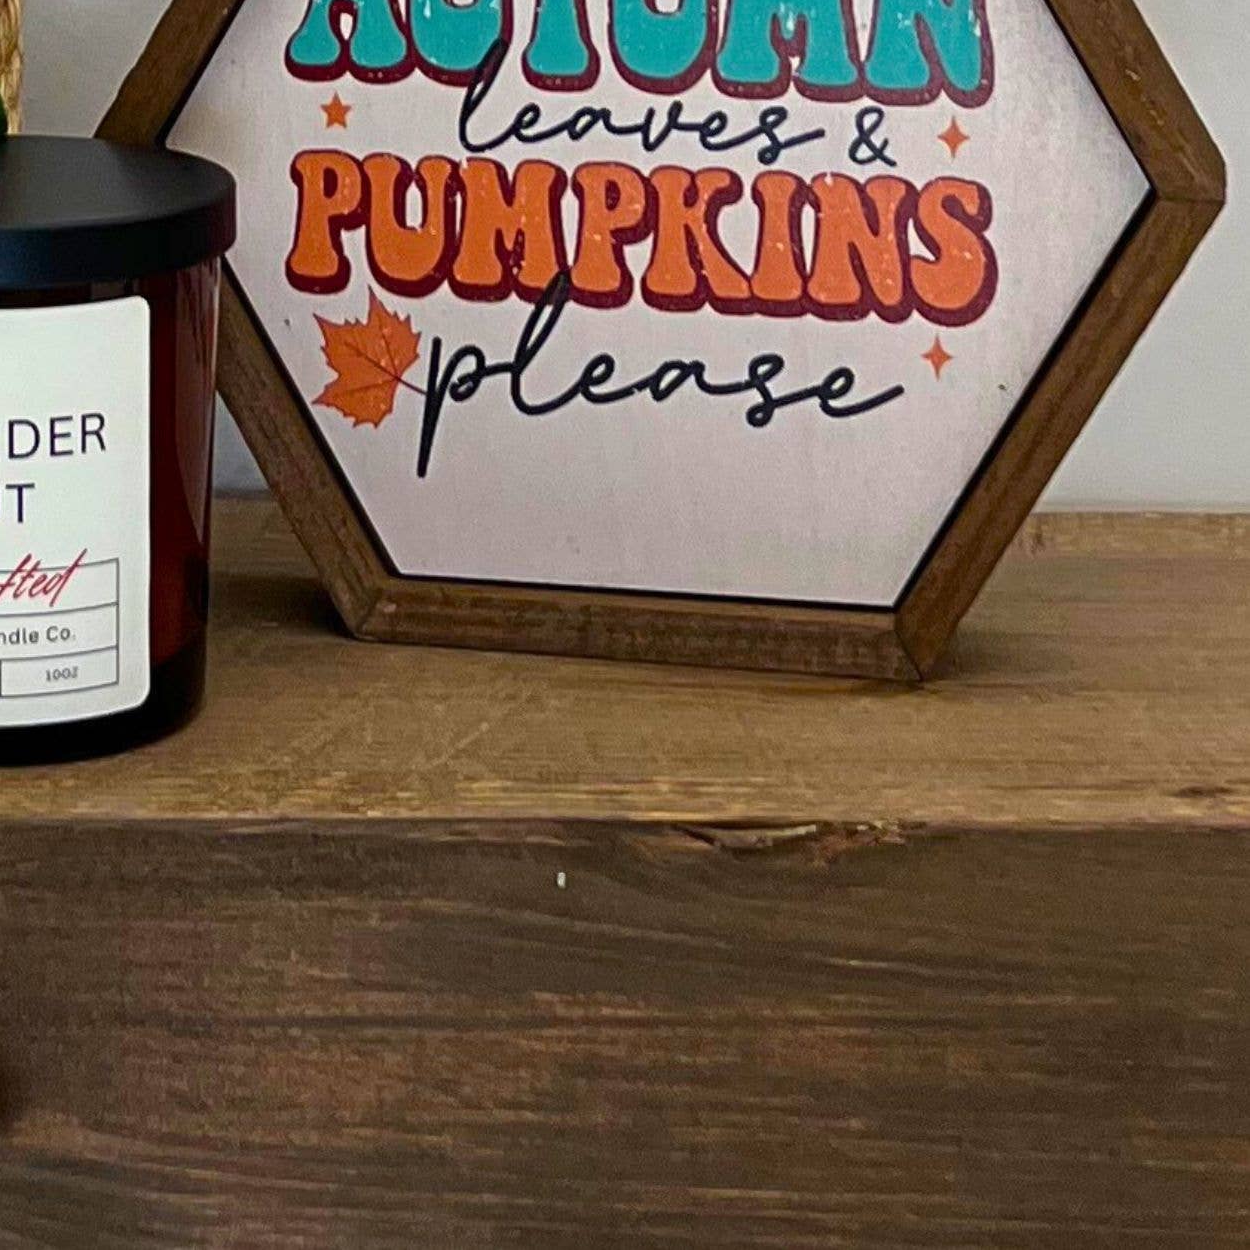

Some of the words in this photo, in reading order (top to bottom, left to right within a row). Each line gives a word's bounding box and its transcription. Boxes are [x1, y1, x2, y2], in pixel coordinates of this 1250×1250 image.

[459, 39, 825, 165] leaves
[848, 105, 898, 167] &
[285, 150, 998, 327] PUMPKINS
[417, 272, 905, 478] please
[45, 625, 76, 643] Co.
